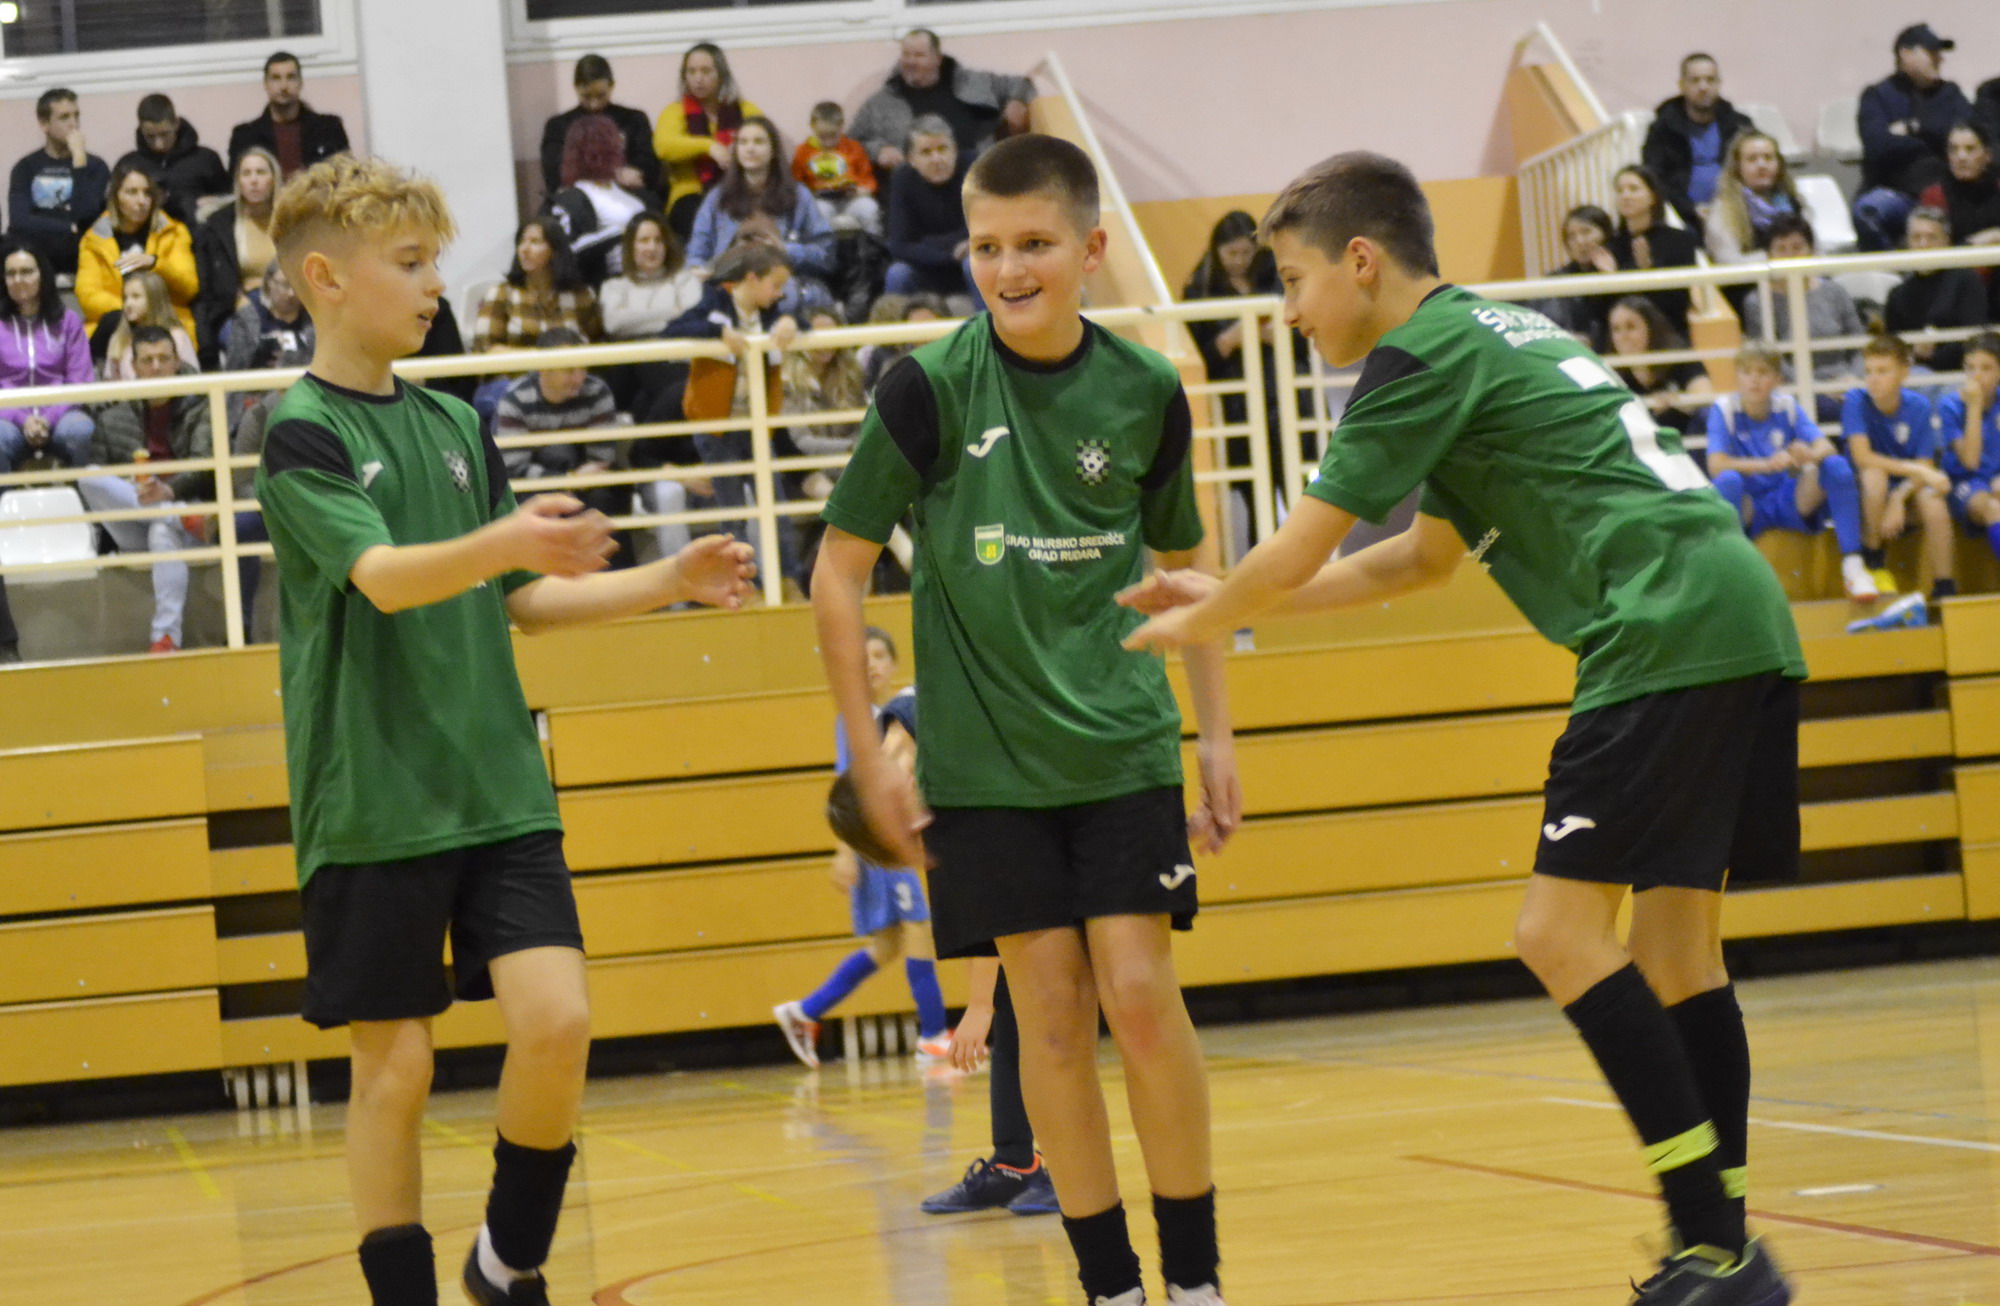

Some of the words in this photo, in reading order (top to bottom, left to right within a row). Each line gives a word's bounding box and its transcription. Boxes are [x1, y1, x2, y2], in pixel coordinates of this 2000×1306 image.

[1005, 535, 1030, 548] GRAD
[1028, 549, 1058, 561] GRAD
[1060, 549, 1101, 561] RUDARA
